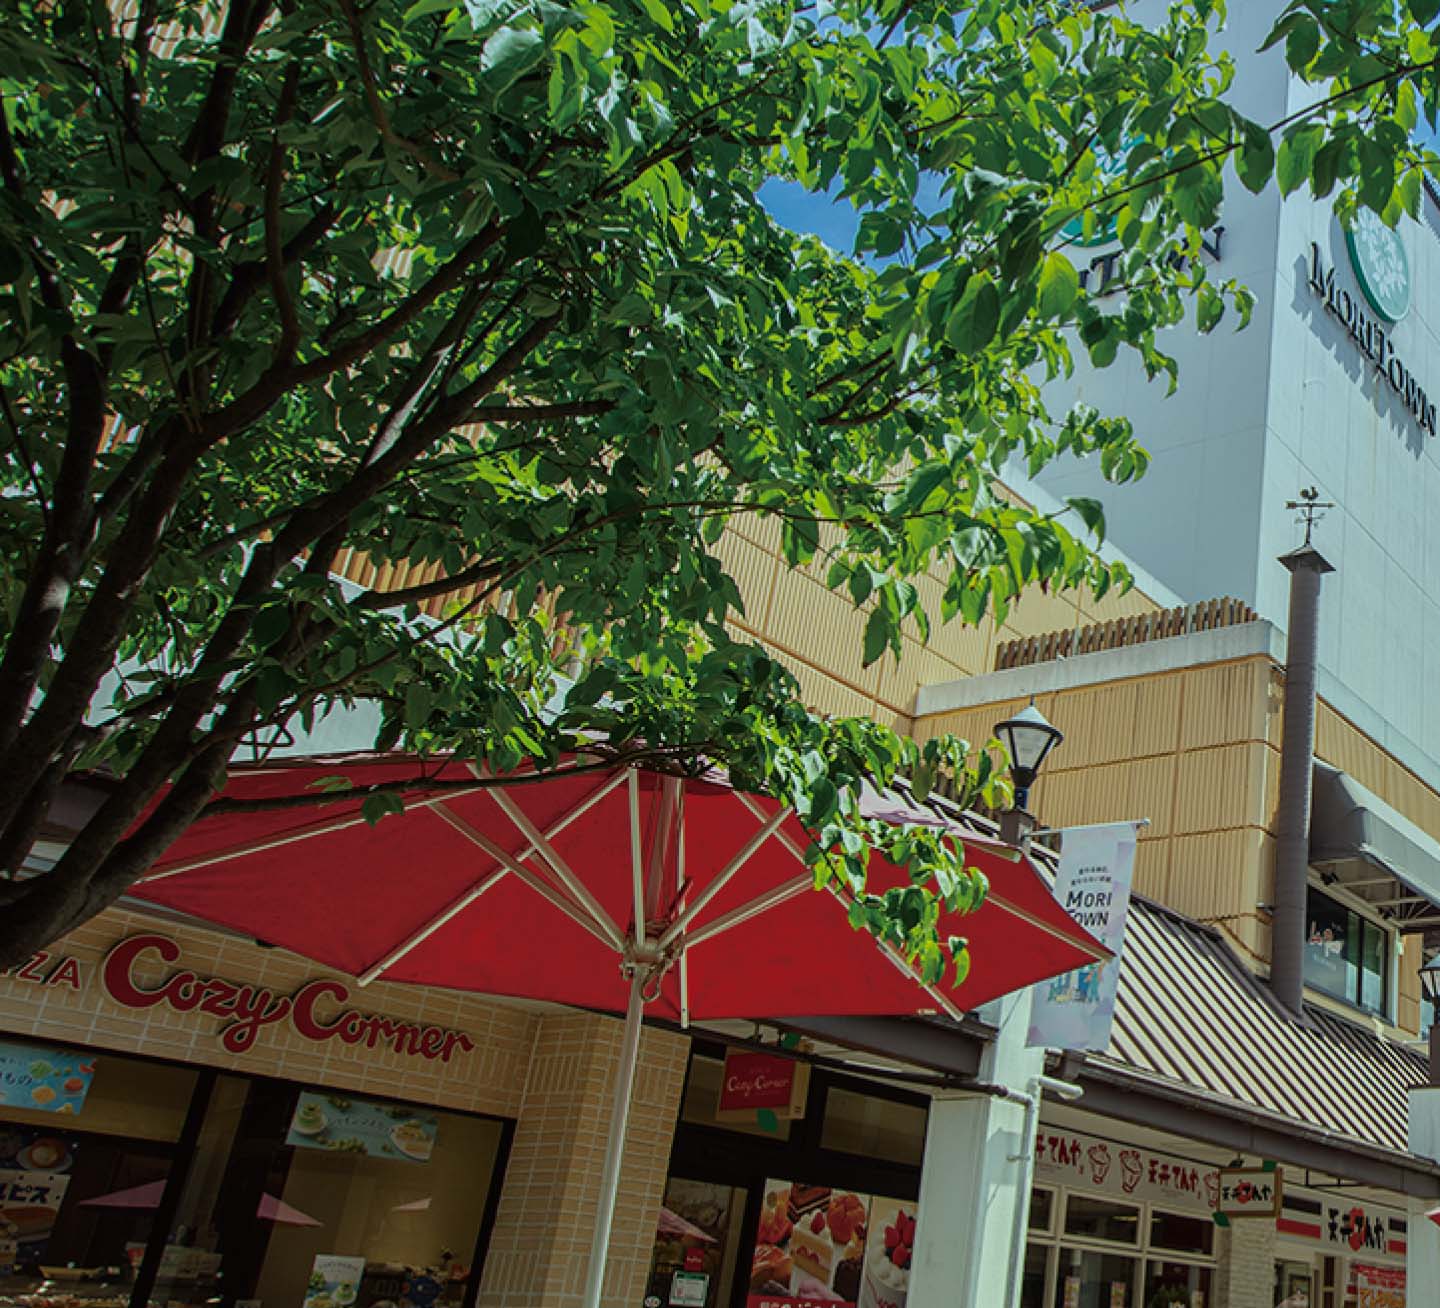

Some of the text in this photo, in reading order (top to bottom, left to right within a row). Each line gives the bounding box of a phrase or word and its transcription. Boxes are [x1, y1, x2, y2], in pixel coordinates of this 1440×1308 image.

[1066, 890, 1112, 907] MORI
[0, 935, 474, 1062] ZA Cozy Corner
